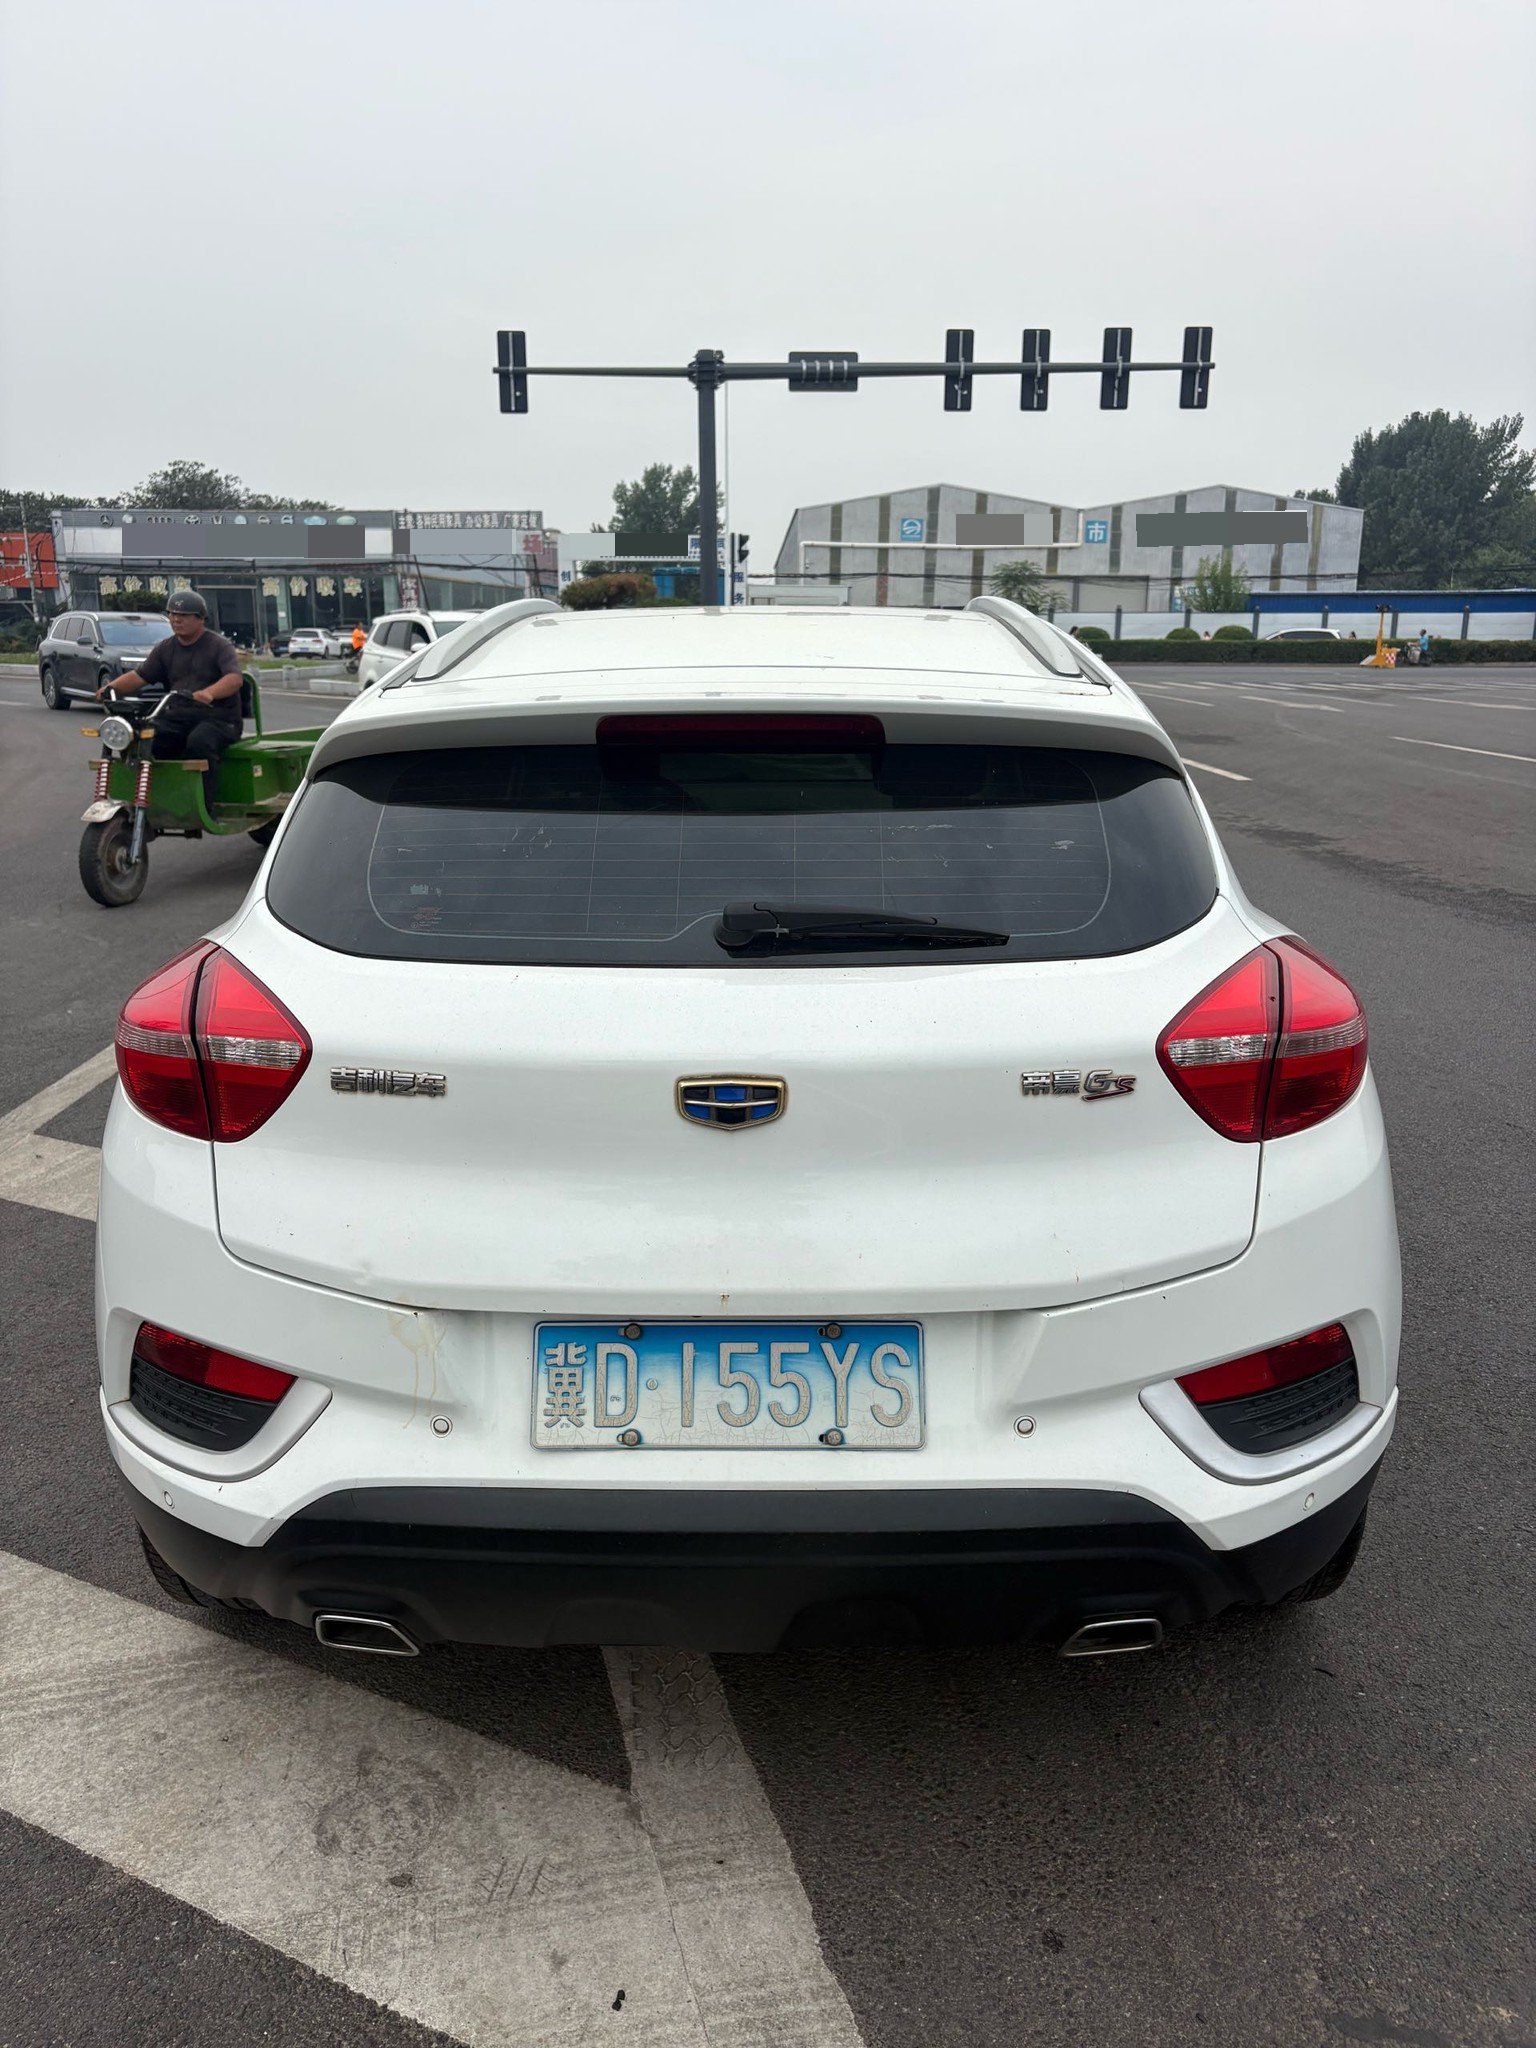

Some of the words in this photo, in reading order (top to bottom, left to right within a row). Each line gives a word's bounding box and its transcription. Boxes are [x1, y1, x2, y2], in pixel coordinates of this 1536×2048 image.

[1088, 522, 1108, 542] 市
[262, 576, 363, 597] 高价收车
[330, 1067, 446, 1097] 吉利汽车
